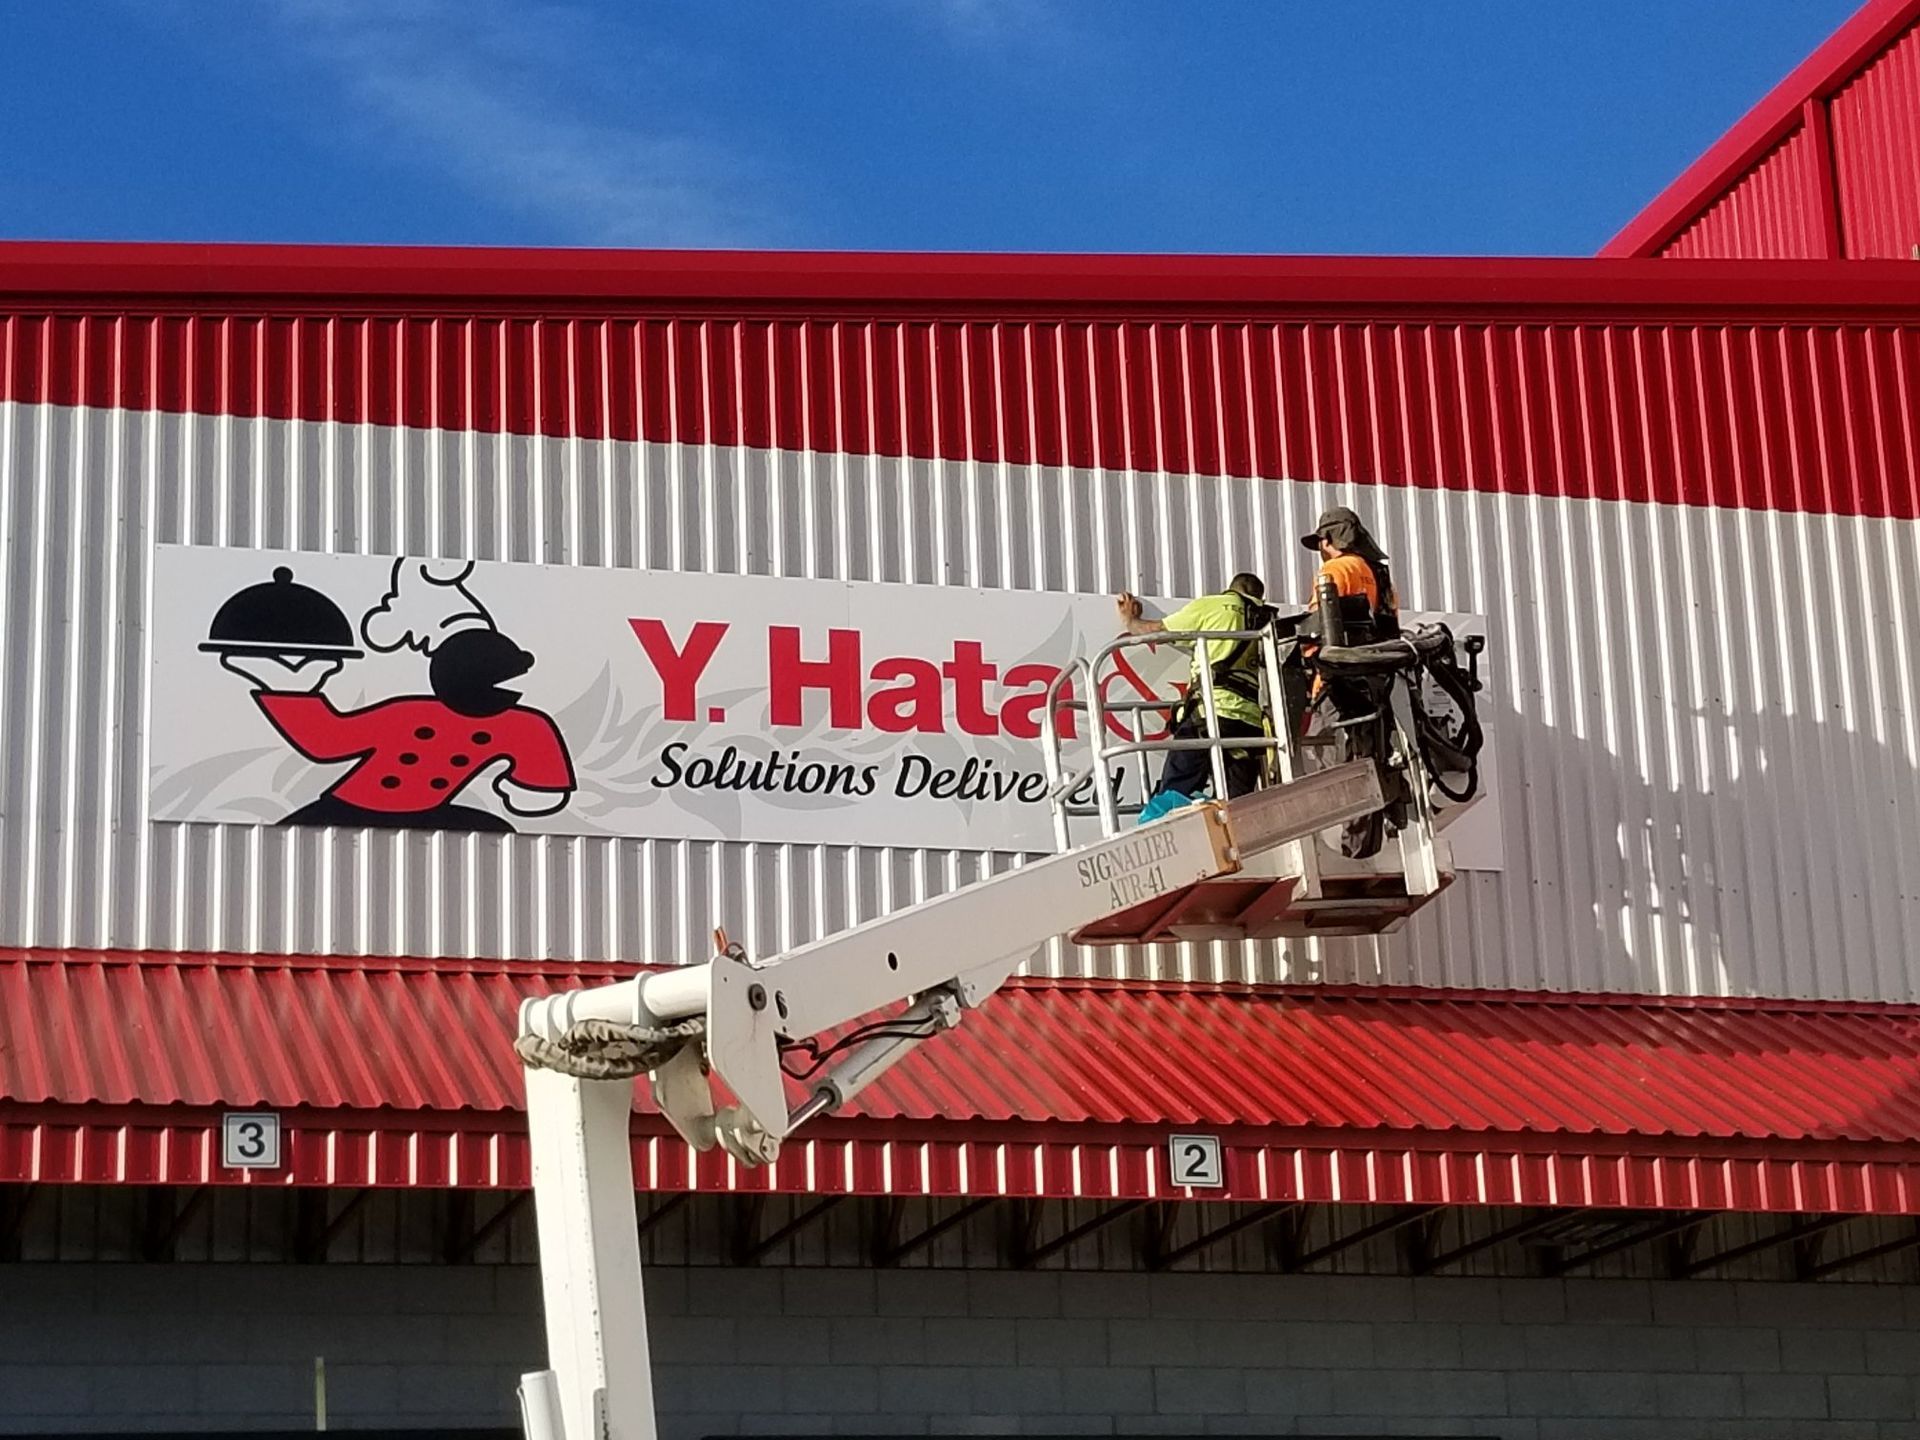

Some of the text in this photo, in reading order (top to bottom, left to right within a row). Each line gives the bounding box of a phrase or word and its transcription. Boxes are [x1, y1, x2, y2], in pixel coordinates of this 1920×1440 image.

[627, 618, 731, 724] Y.
[768, 624, 1078, 741] Hata
[650, 741, 880, 796] Solutions
[893, 754, 1125, 805] Deliveed
[1077, 829, 1179, 888] SIGNALIER
[1109, 865, 1168, 910] ATR-41
[237, 1122, 266, 1159] 3
[1184, 1144, 1209, 1178] 2
